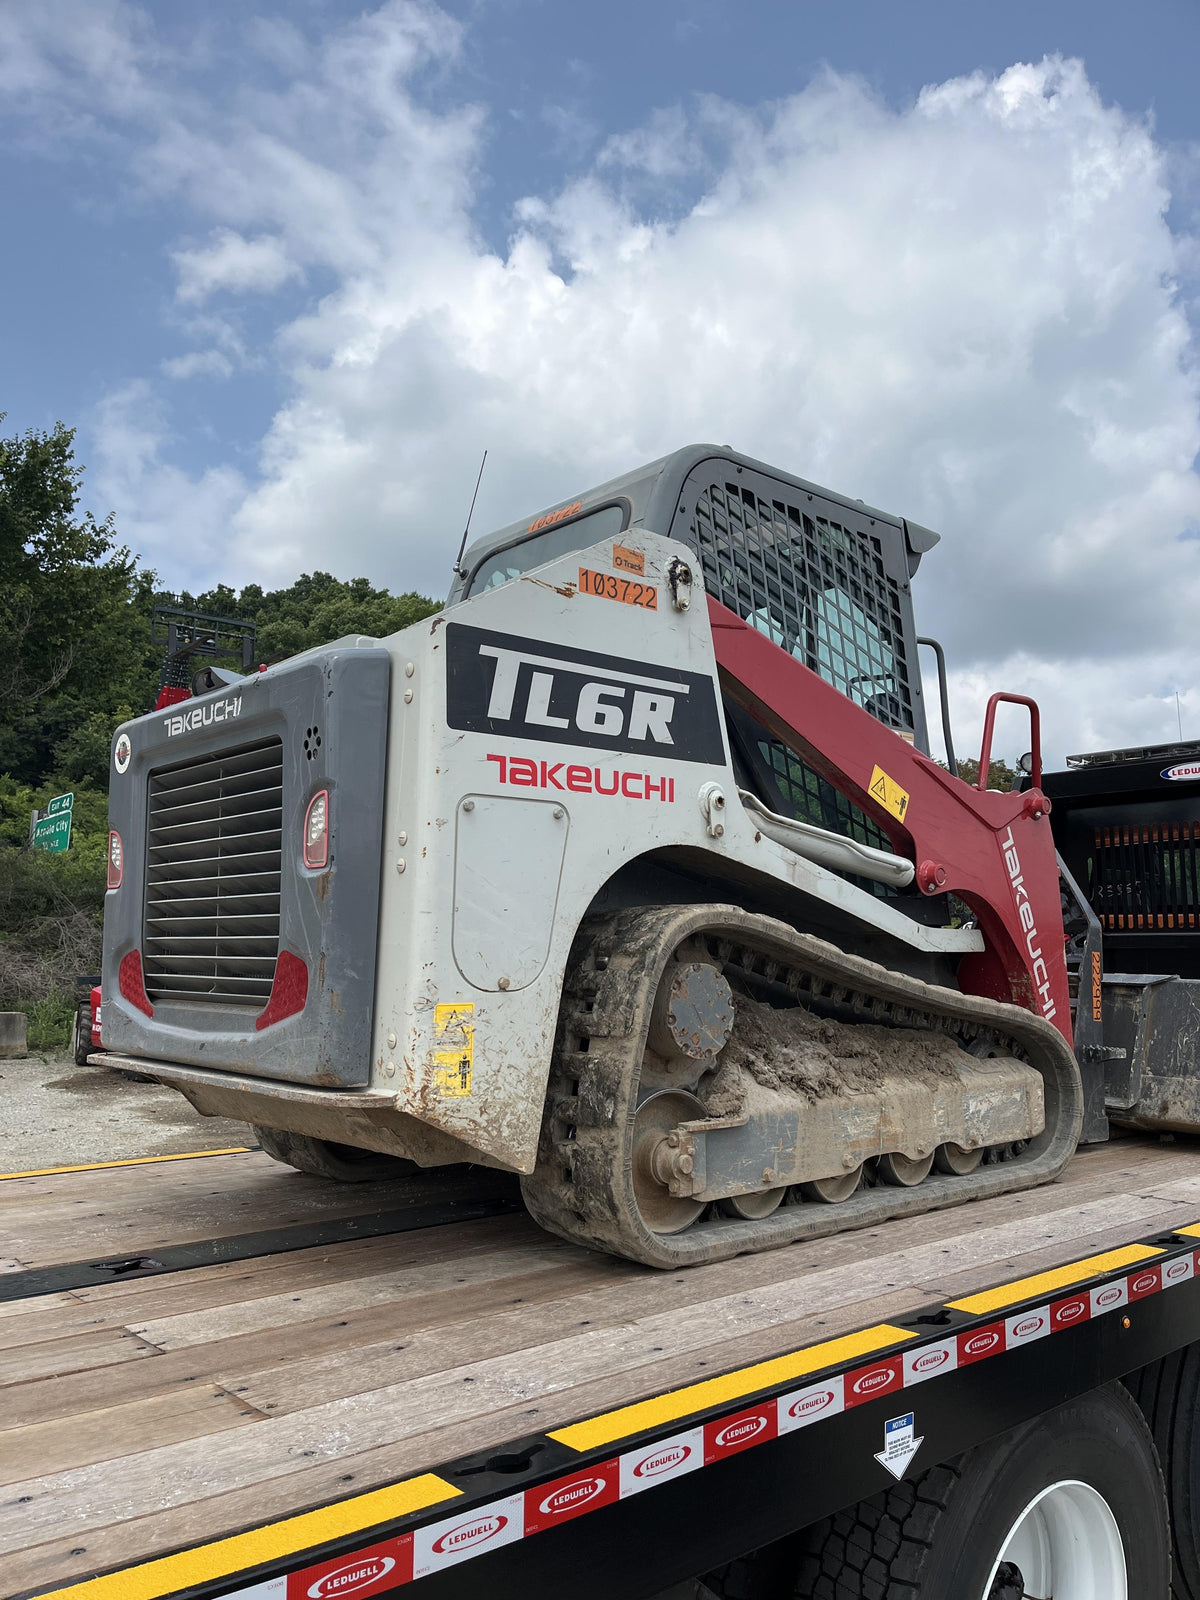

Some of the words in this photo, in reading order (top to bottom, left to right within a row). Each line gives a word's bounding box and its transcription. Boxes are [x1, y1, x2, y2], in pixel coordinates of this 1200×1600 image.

[623, 559, 643, 573] Track
[581, 569, 656, 609] 103722
[478, 644, 690, 745] TL6R
[486, 753, 675, 803] TAKEUCHI
[1171, 766, 1200, 777] LEDW
[61, 797, 70, 808] 44
[55, 820, 69, 833] City
[1092, 952, 1101, 1021] 222999
[1019, 1320, 1038, 1333] LEDWELL
[971, 1337, 993, 1350] LEDWELL
[919, 1354, 942, 1368] LEDWELL
[862, 1373, 887, 1389] LEDWELL
[798, 1396, 826, 1412] LEDWELL
[726, 1422, 758, 1440] LEDWELL
[891, 1418, 908, 1430] NOTICE
[646, 1451, 681, 1471] LEDWELL
[553, 1484, 594, 1507] LEDWELL
[448, 1522, 494, 1546] LEDWELL
[326, 1564, 379, 1590] LEDWELL
